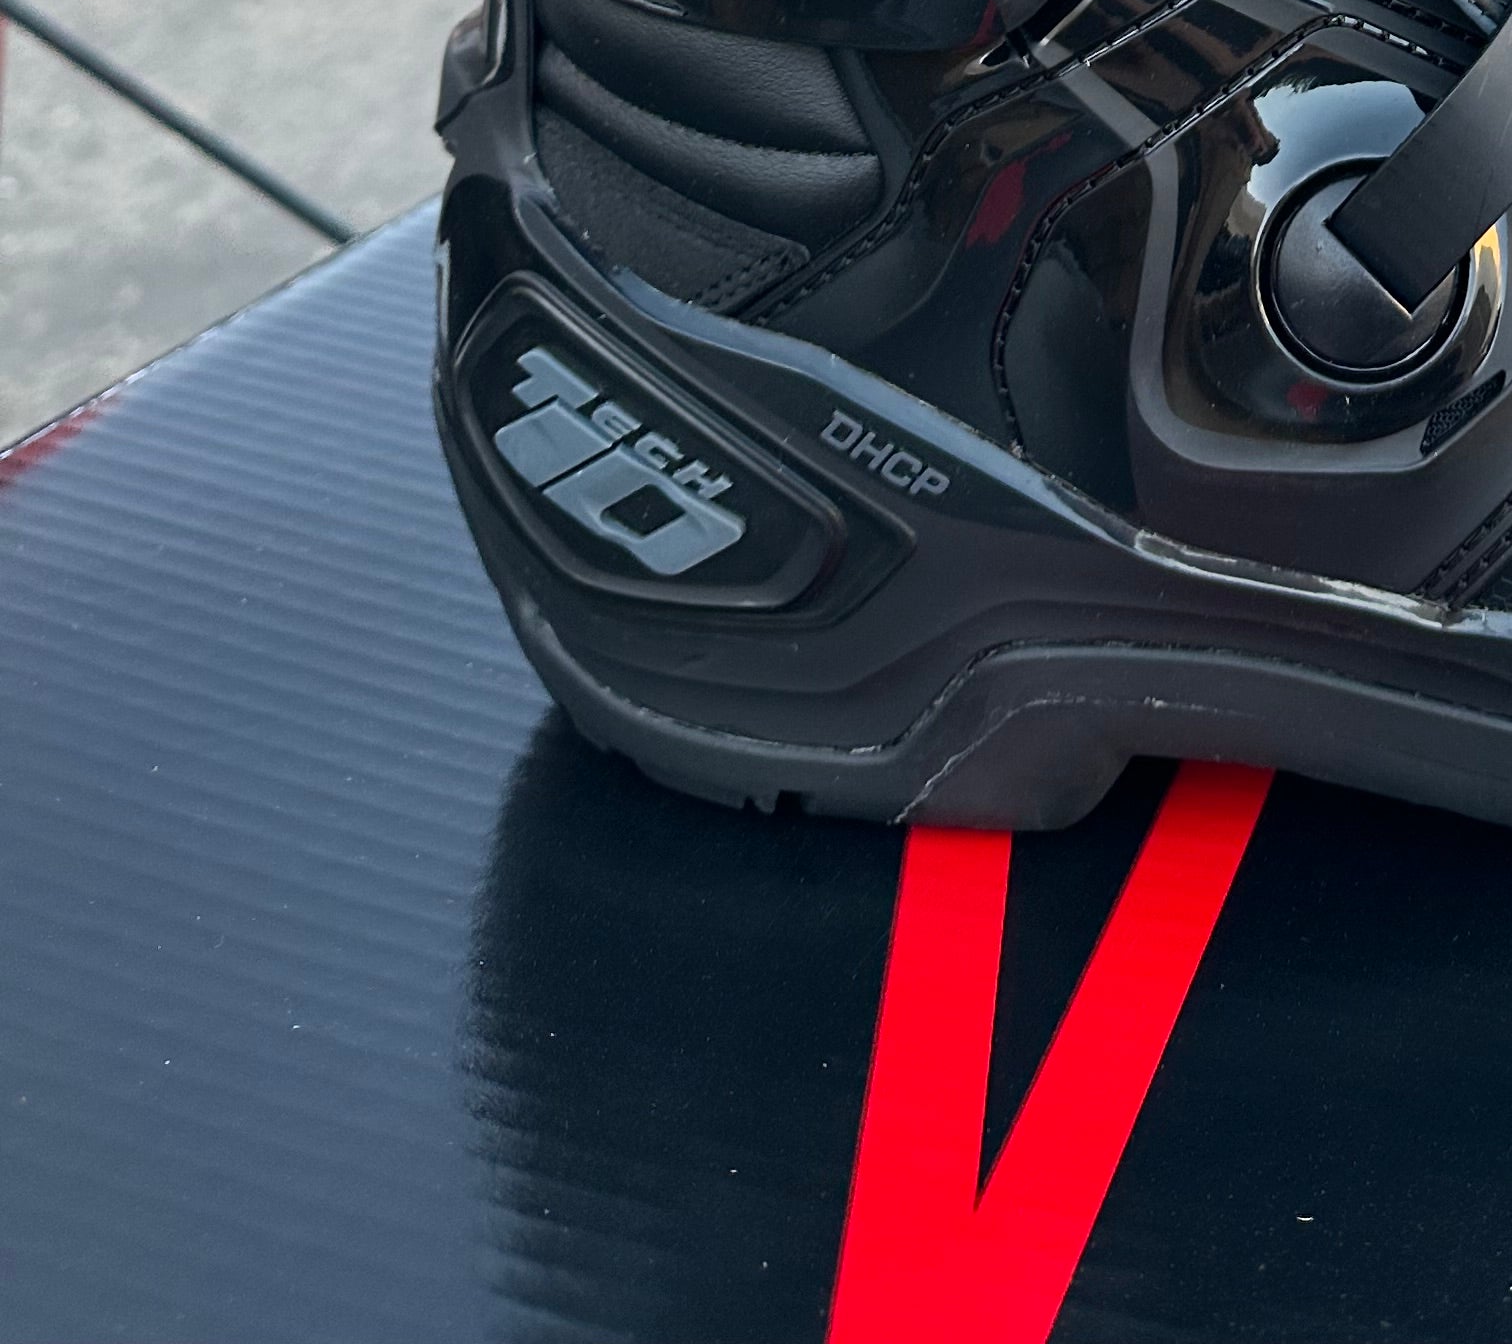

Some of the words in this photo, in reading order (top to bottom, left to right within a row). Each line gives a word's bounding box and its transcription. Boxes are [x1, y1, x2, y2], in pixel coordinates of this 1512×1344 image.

[495, 400, 747, 576] 10
[512, 346, 734, 500] TECH
[821, 410, 950, 495] DHCP
